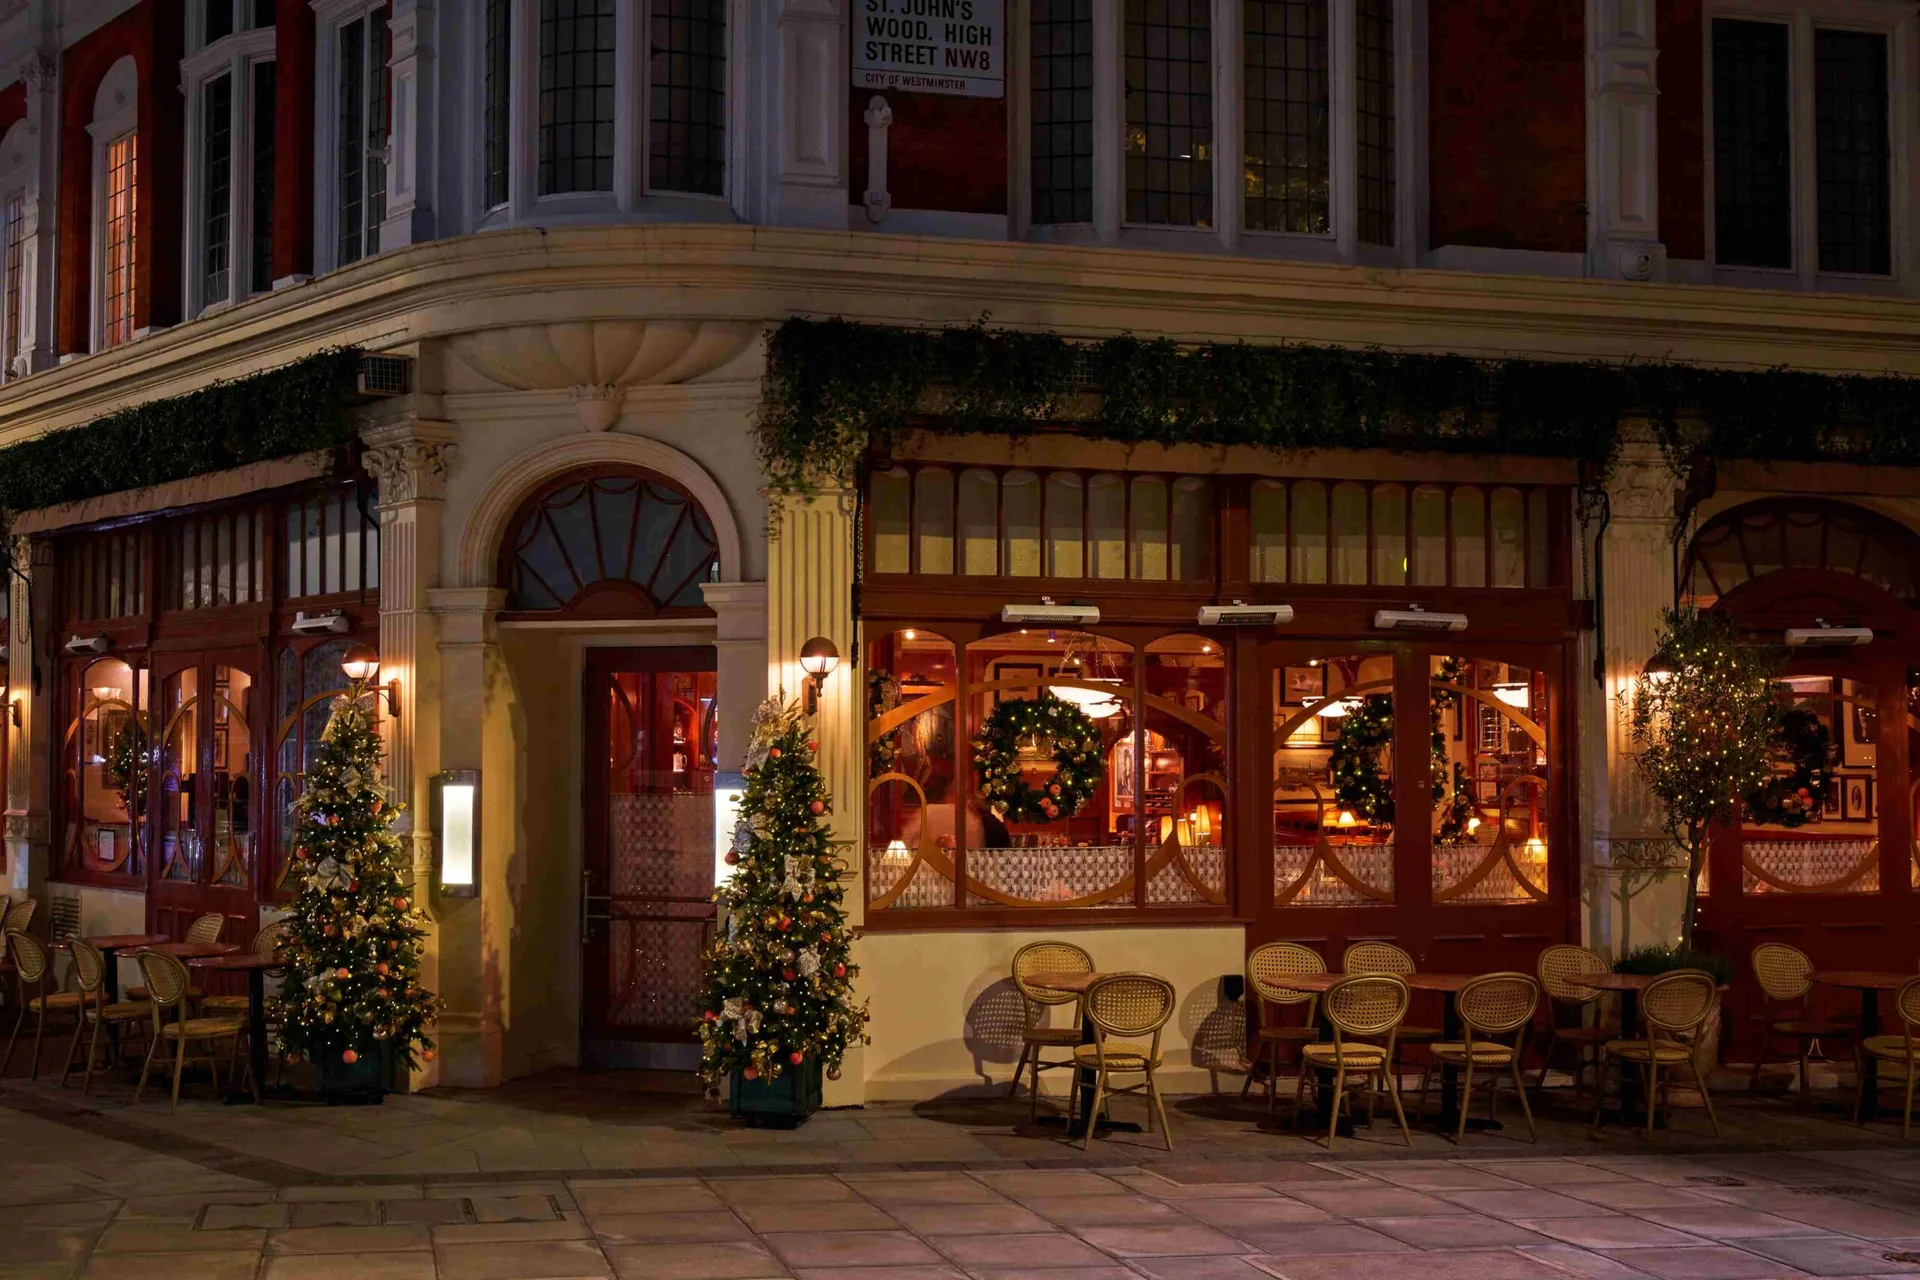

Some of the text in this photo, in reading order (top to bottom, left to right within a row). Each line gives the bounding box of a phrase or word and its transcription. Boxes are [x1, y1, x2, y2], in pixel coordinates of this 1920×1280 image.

[866, 0, 973, 20] ST. JOHN'S
[866, 16, 992, 46] WOOD. HIGH
[865, 41, 990, 70] STREET NW8
[865, 73, 966, 90] CITY OF WESTMINSTER
